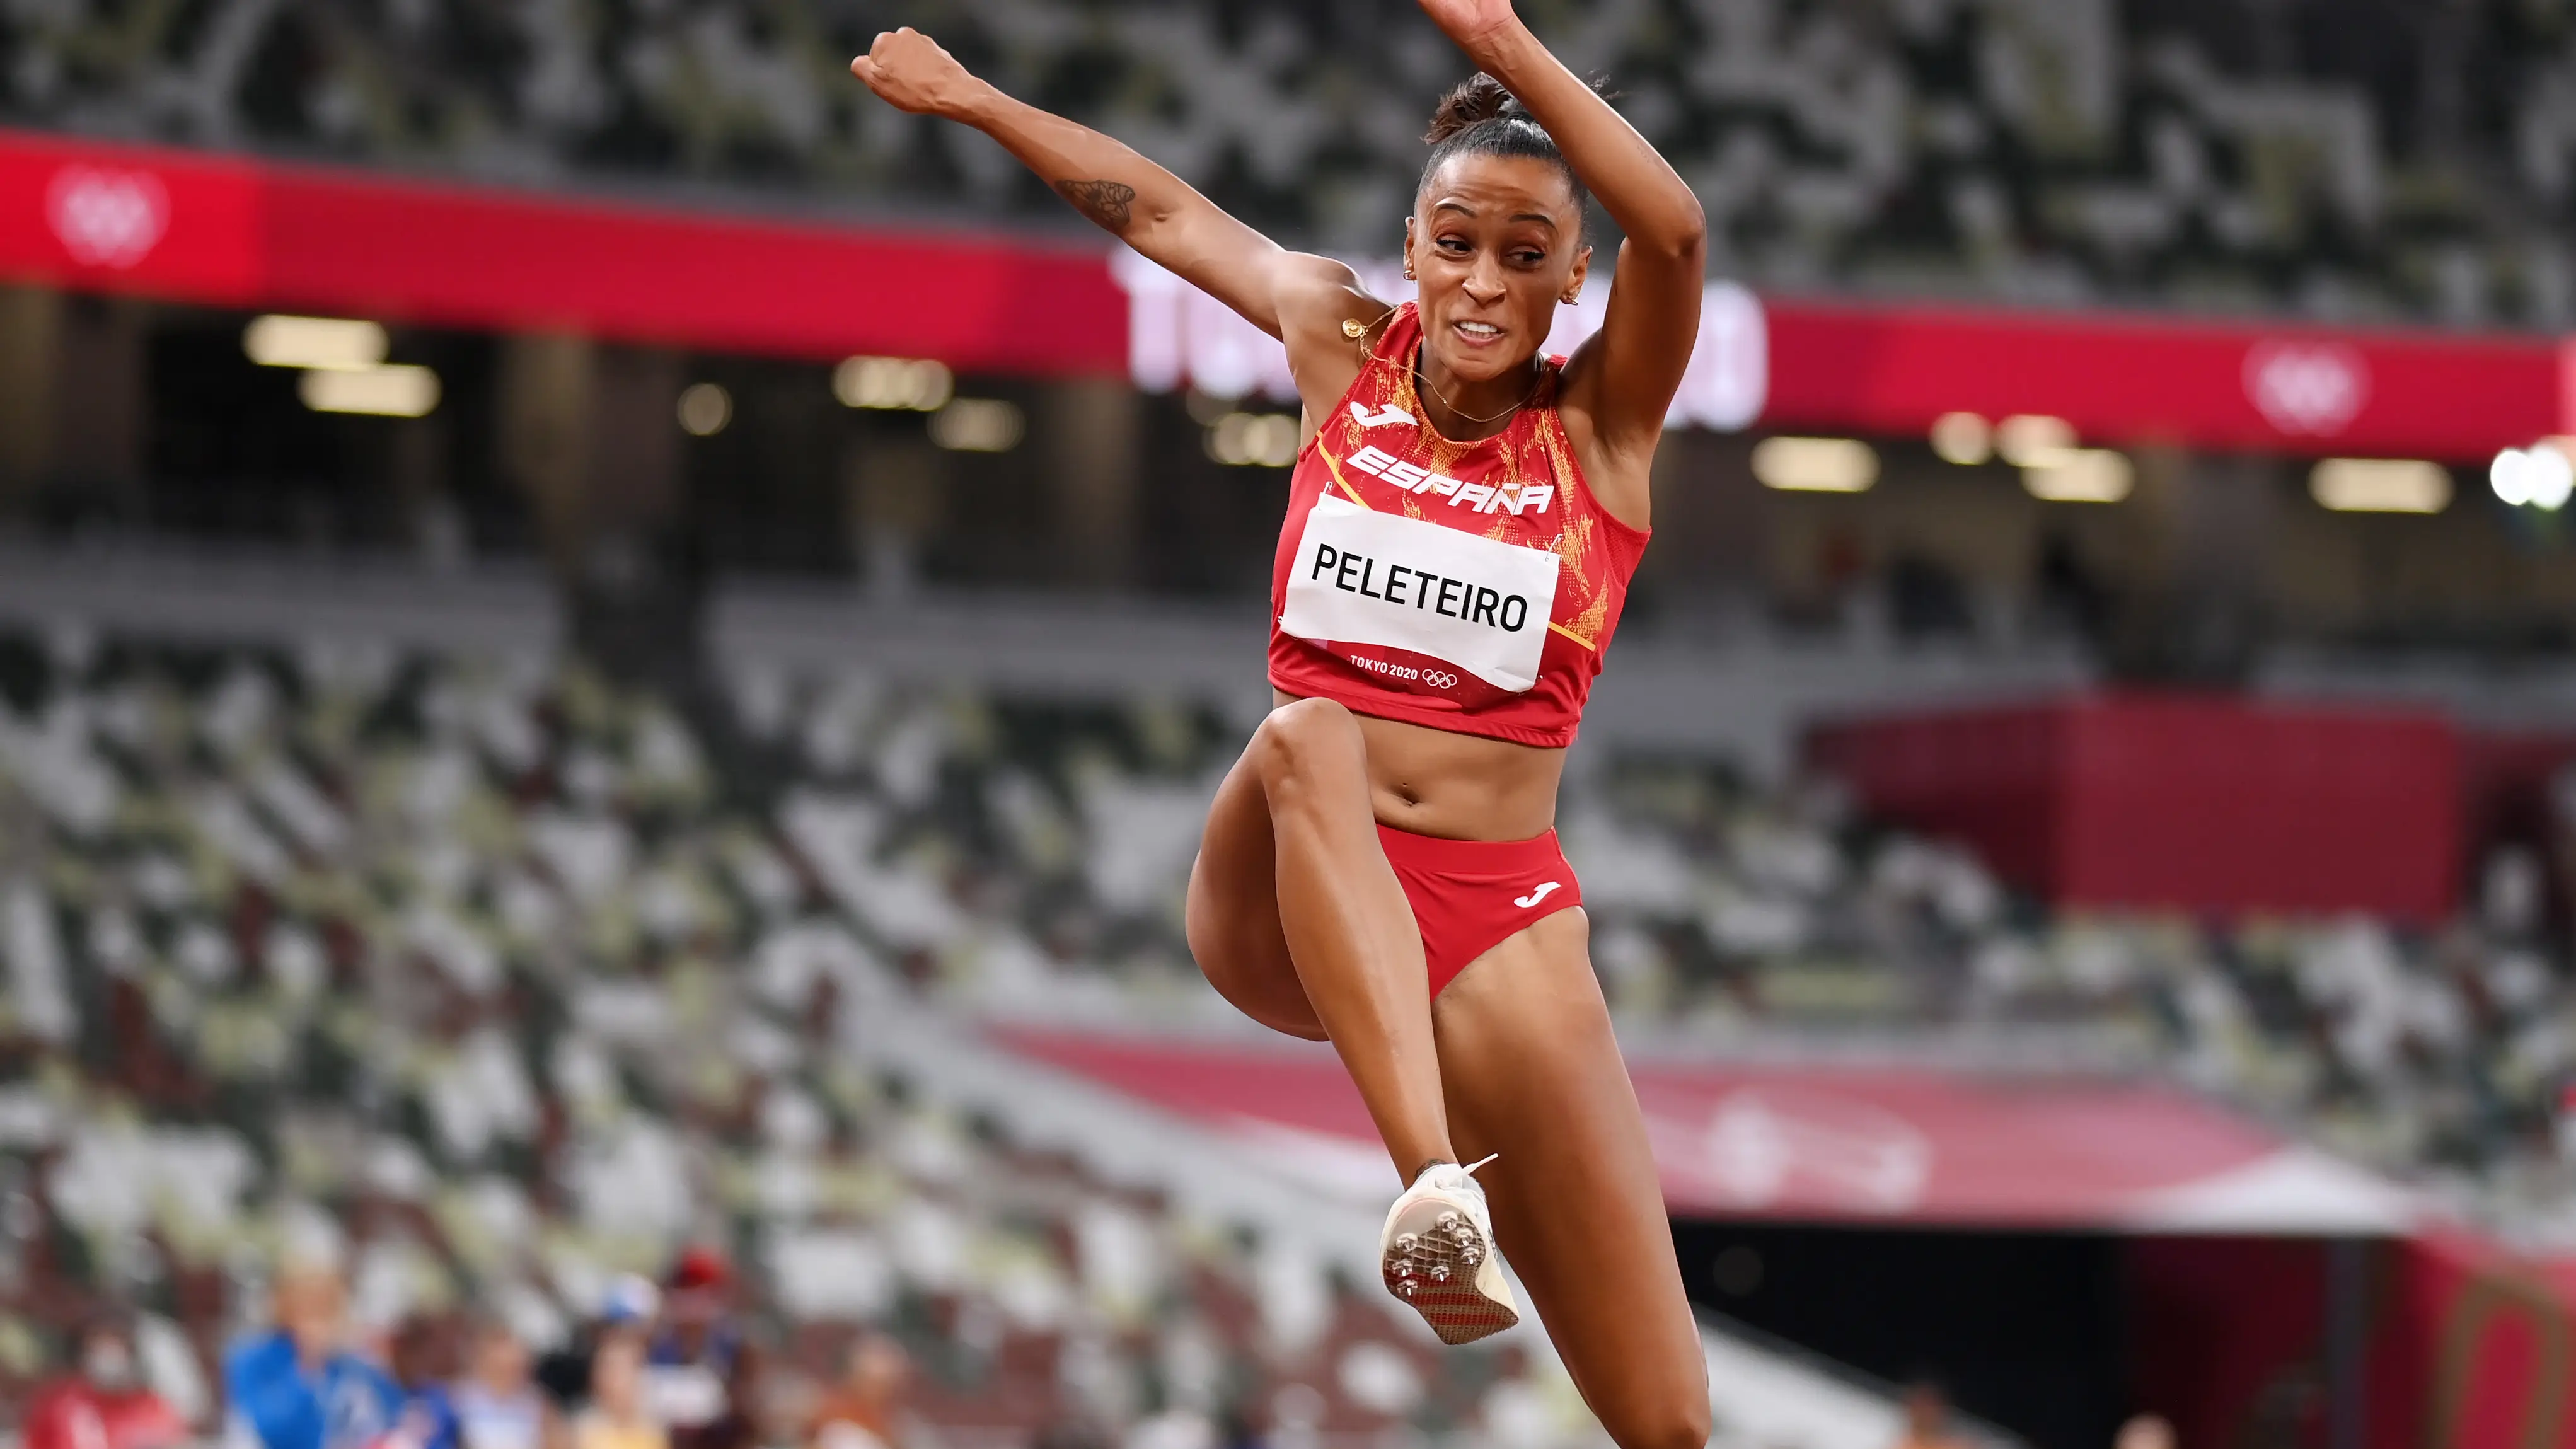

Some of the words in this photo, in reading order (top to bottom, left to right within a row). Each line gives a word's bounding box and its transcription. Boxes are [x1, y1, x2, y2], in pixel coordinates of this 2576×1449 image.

[1346, 445, 1554, 516] ESPAÑA
[1311, 543, 1527, 632] PELETEIRO
[1350, 655, 1388, 674] TOKYO
[1389, 664, 1418, 680] 2020
